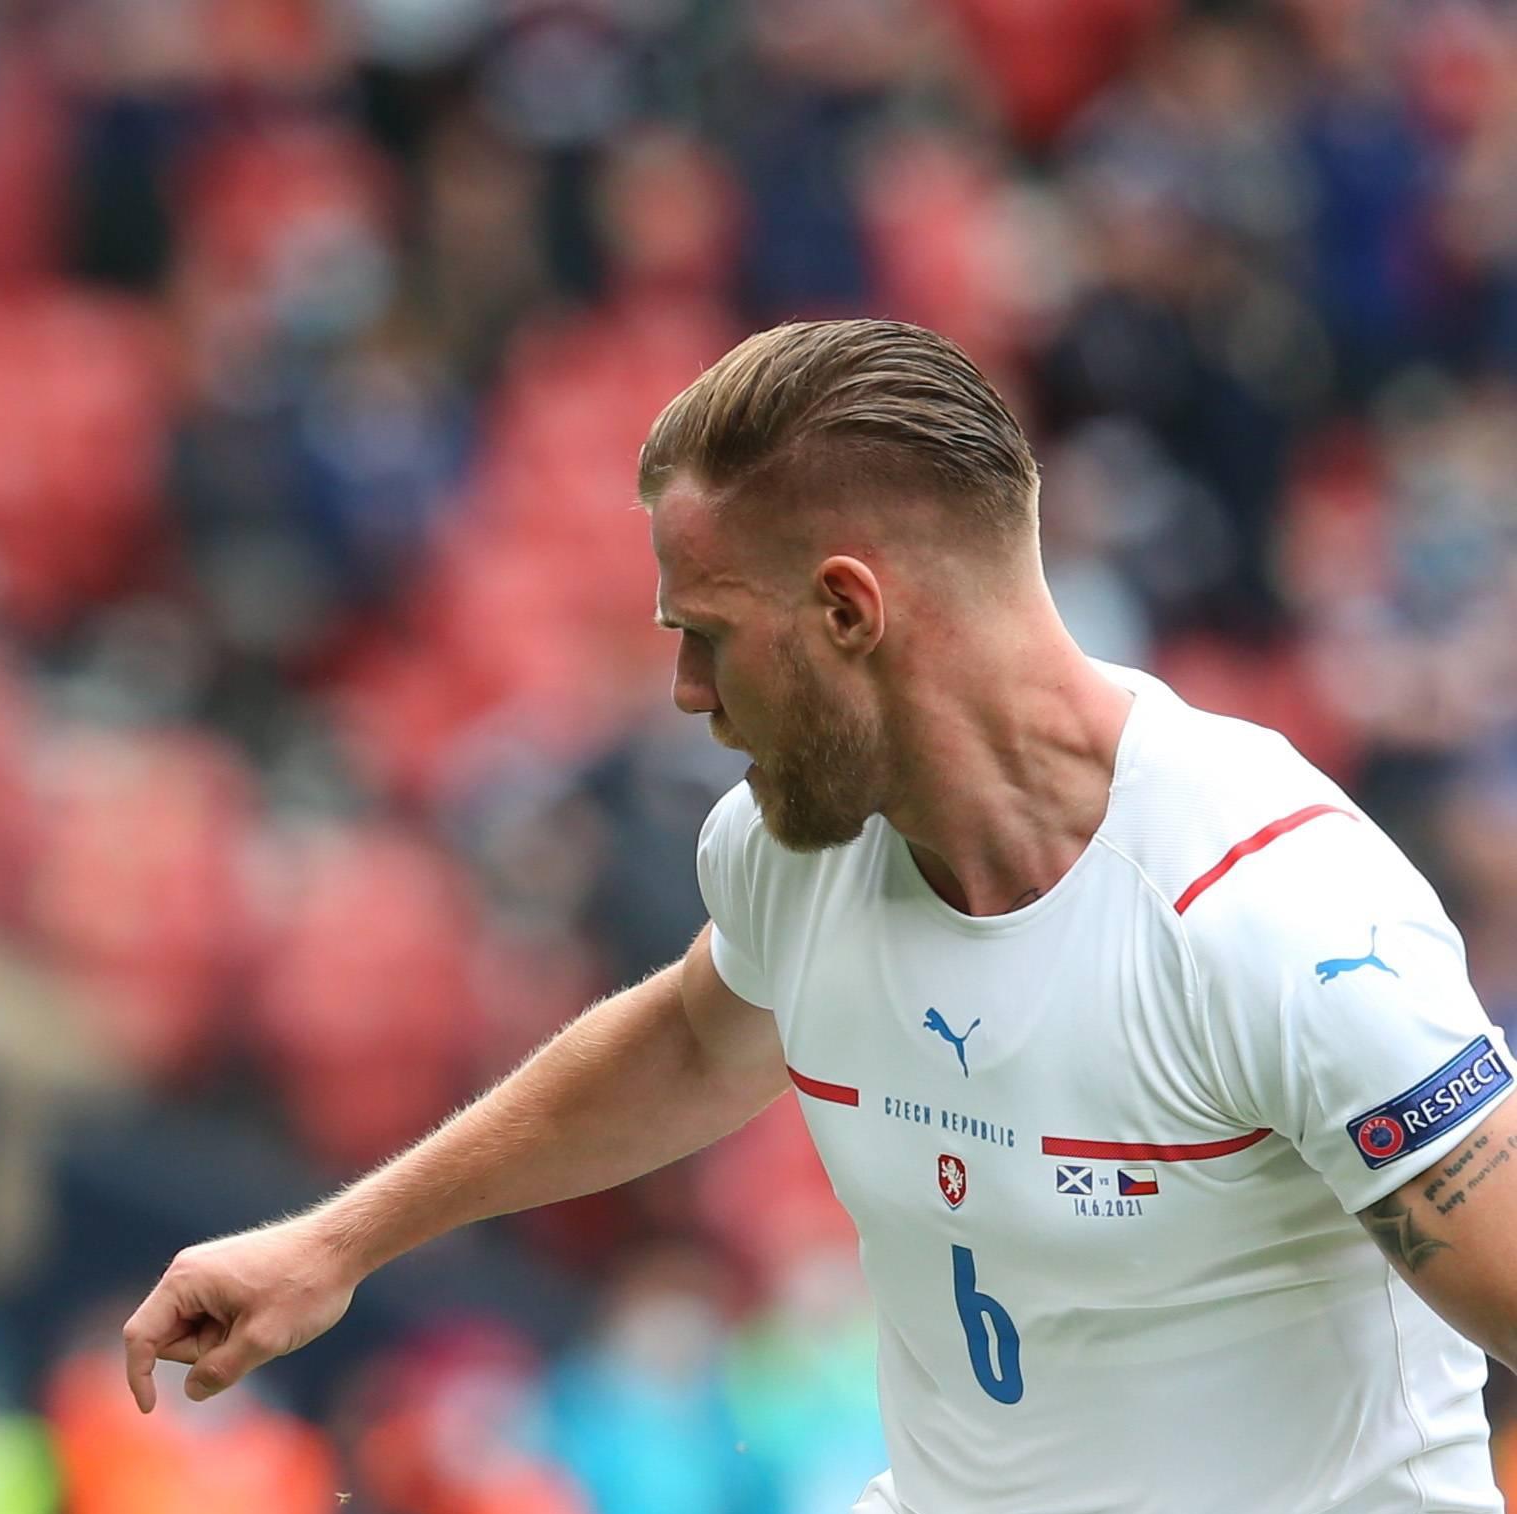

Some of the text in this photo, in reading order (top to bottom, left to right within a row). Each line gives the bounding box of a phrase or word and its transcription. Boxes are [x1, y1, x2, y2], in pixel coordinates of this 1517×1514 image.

[1402, 1049, 1502, 1134] RESPECT
[885, 1096, 1015, 1148] CZECH REPUBLIC
[1363, 1119, 1388, 1135] UEFA
[1074, 1198, 1143, 1217] 14.6.2021
[951, 1243, 1024, 1405] 6
